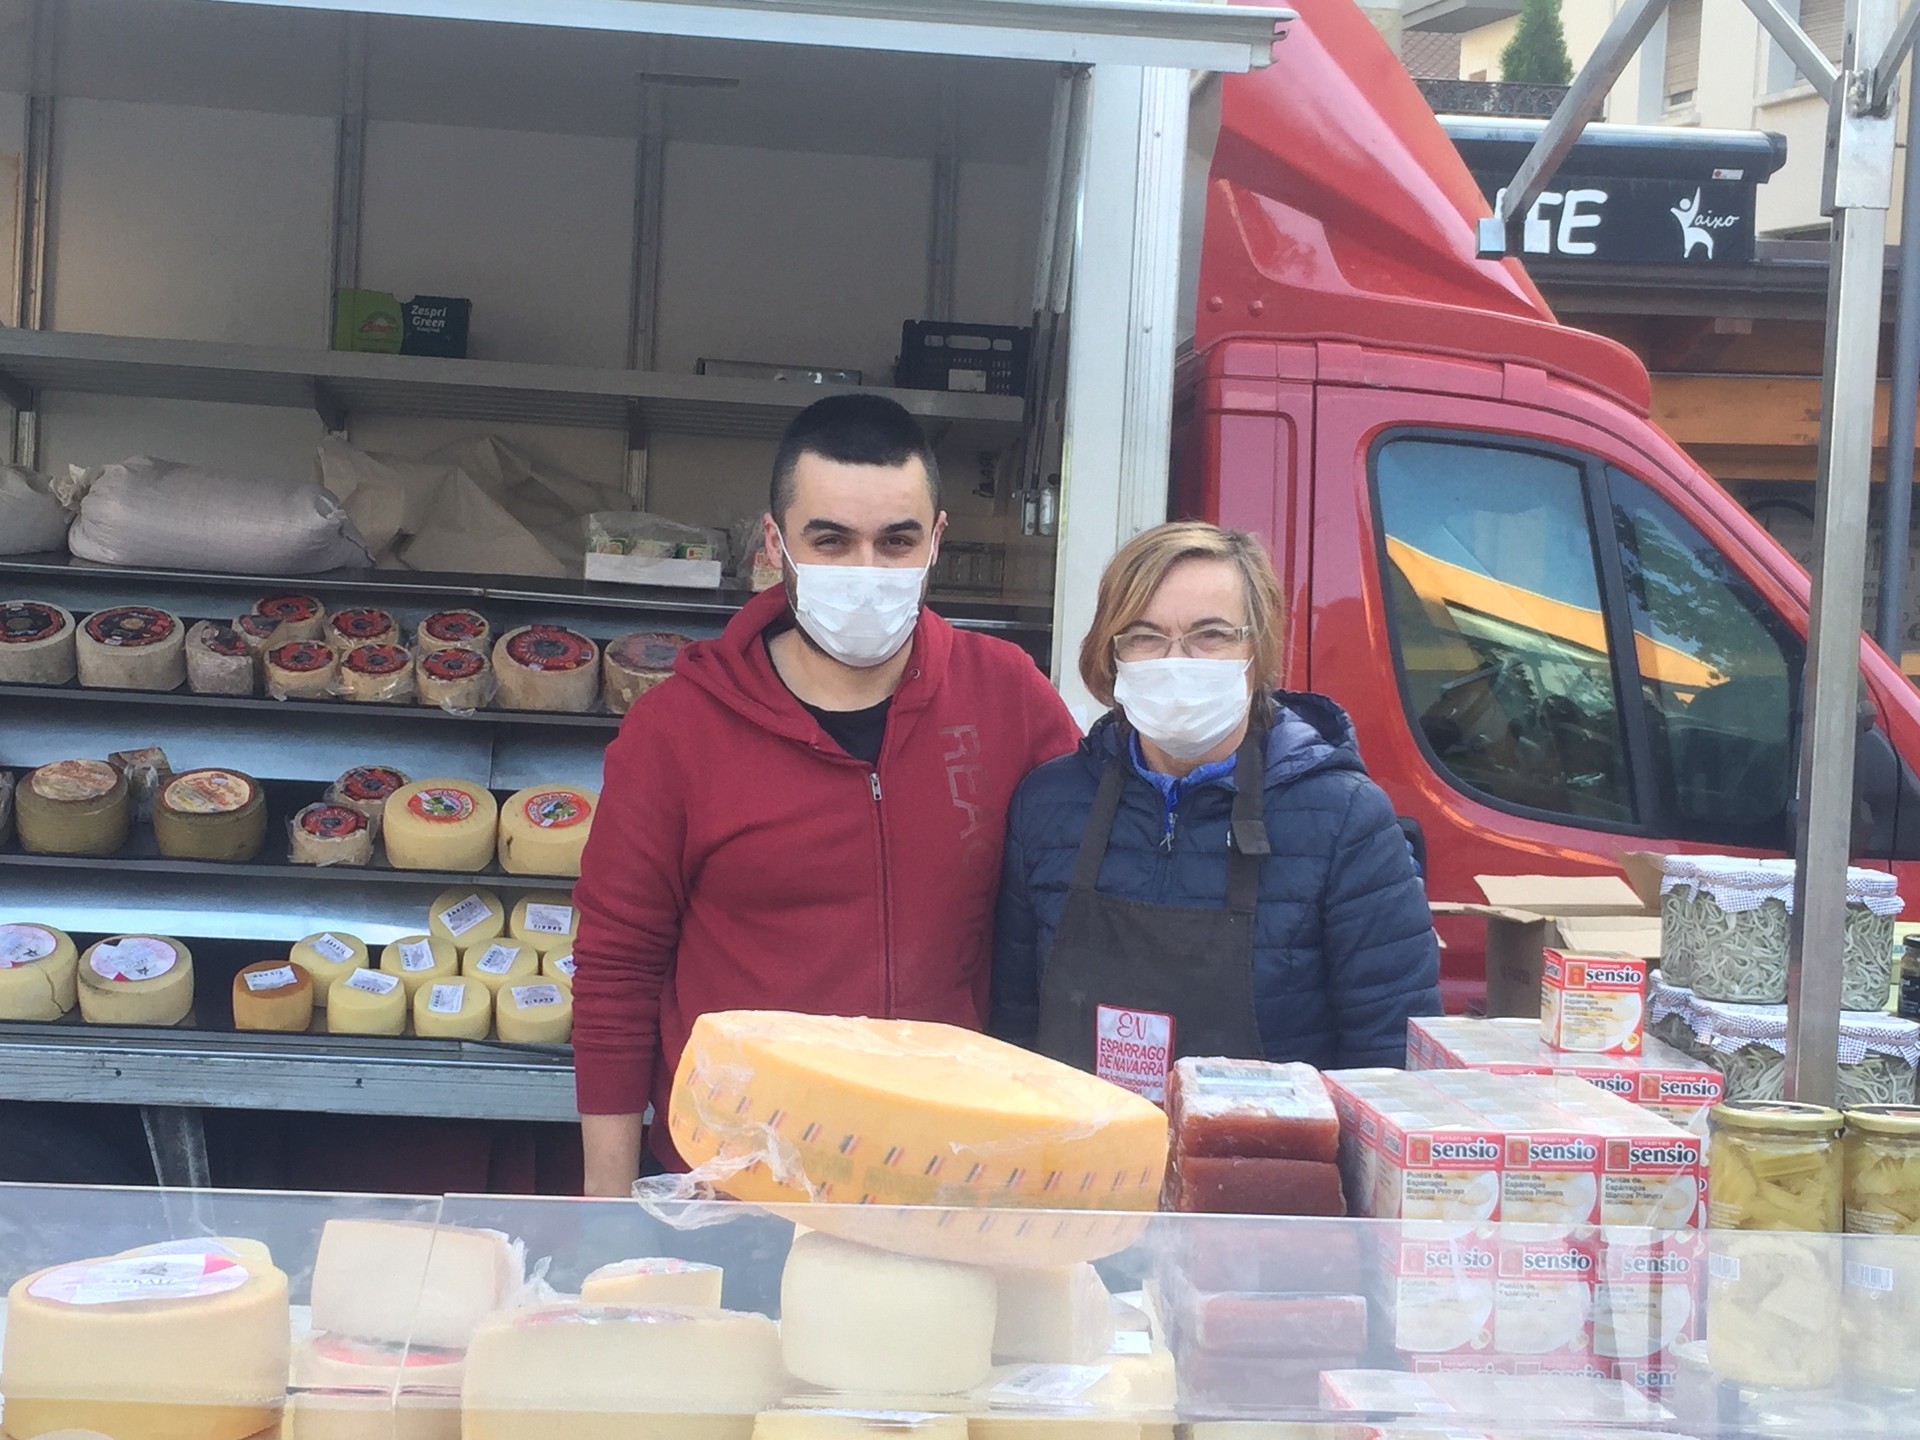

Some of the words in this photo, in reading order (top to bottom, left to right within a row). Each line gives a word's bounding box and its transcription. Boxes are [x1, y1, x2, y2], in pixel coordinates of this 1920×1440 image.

[412, 316, 446, 328] Green
[1586, 967, 1641, 983] sensio
[1099, 1054, 1113, 1069] DE
[1113, 1057, 1164, 1077] NAVARRA
[1660, 1080, 1719, 1096] sensio
[1432, 1139, 1498, 1158] sensio
[1530, 1140, 1596, 1160] sensio
[1630, 1143, 1697, 1163] sensio
[1524, 1250, 1590, 1269] sensio
[1623, 1253, 1690, 1272] sensio
